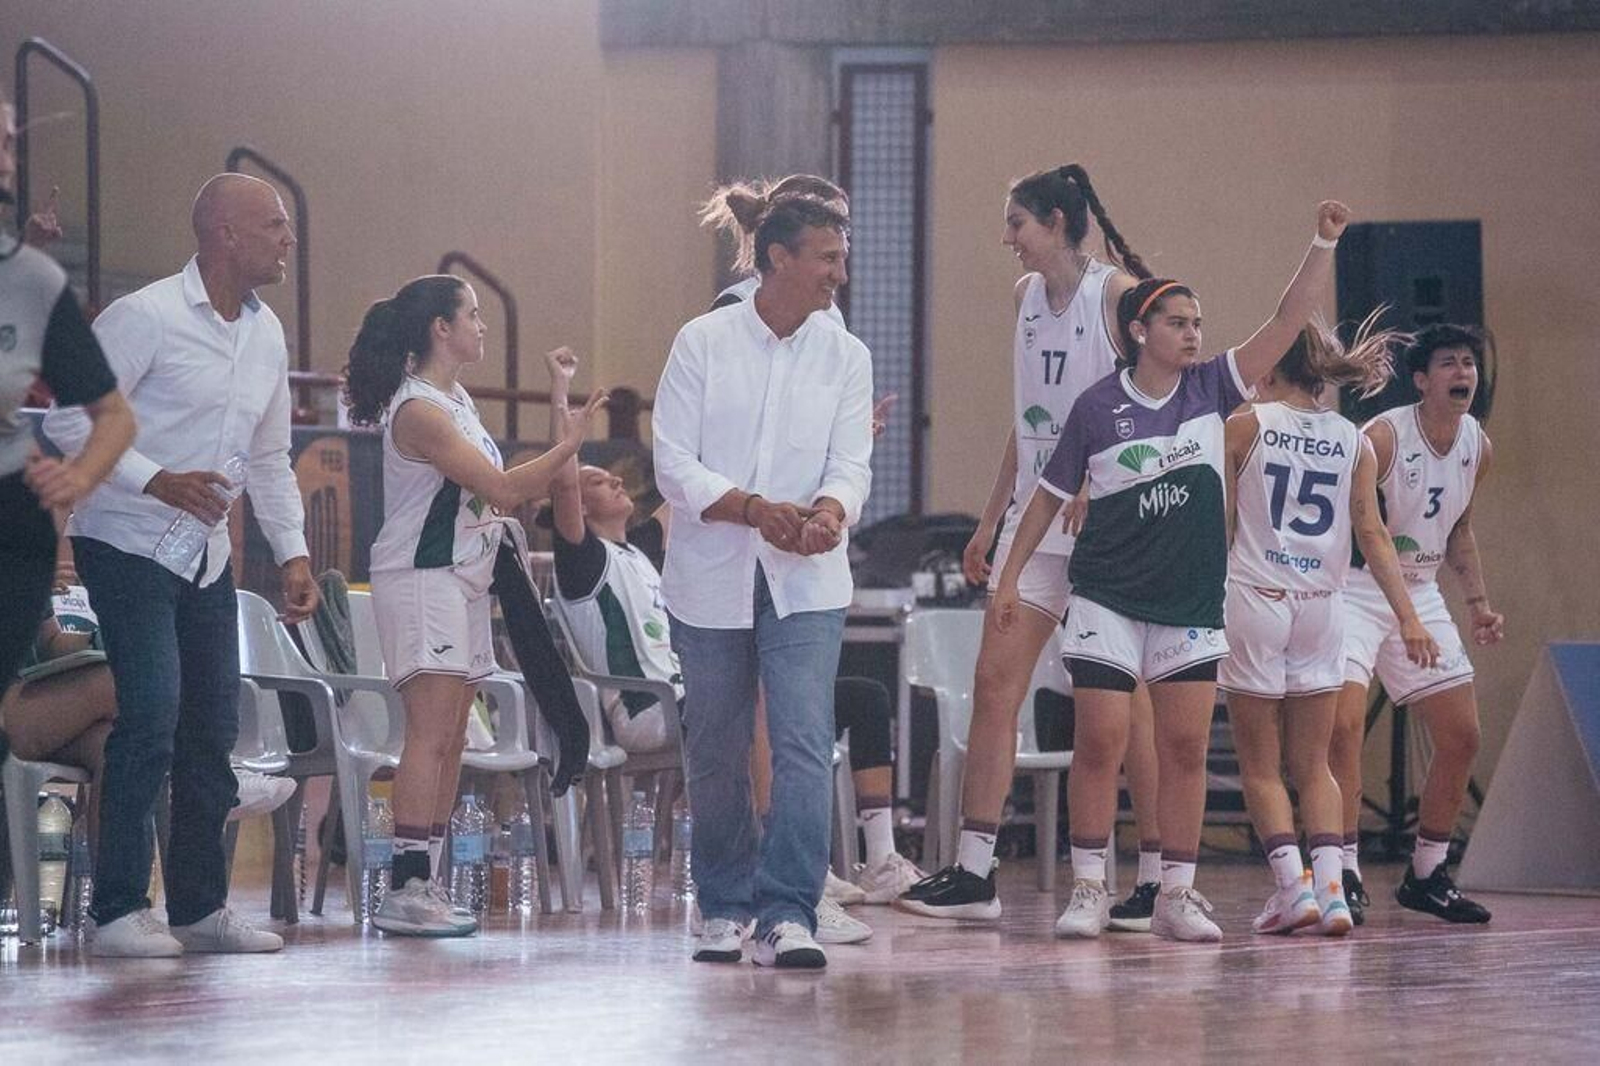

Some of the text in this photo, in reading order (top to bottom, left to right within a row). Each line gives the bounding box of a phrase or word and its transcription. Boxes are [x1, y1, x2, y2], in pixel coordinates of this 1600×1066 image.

[1041, 350, 1067, 385] 17
[1264, 429, 1345, 458] ORTEGA
[1139, 482, 1190, 519] Mijas
[1264, 462, 1338, 537] 15
[1424, 487, 1444, 519] 3
